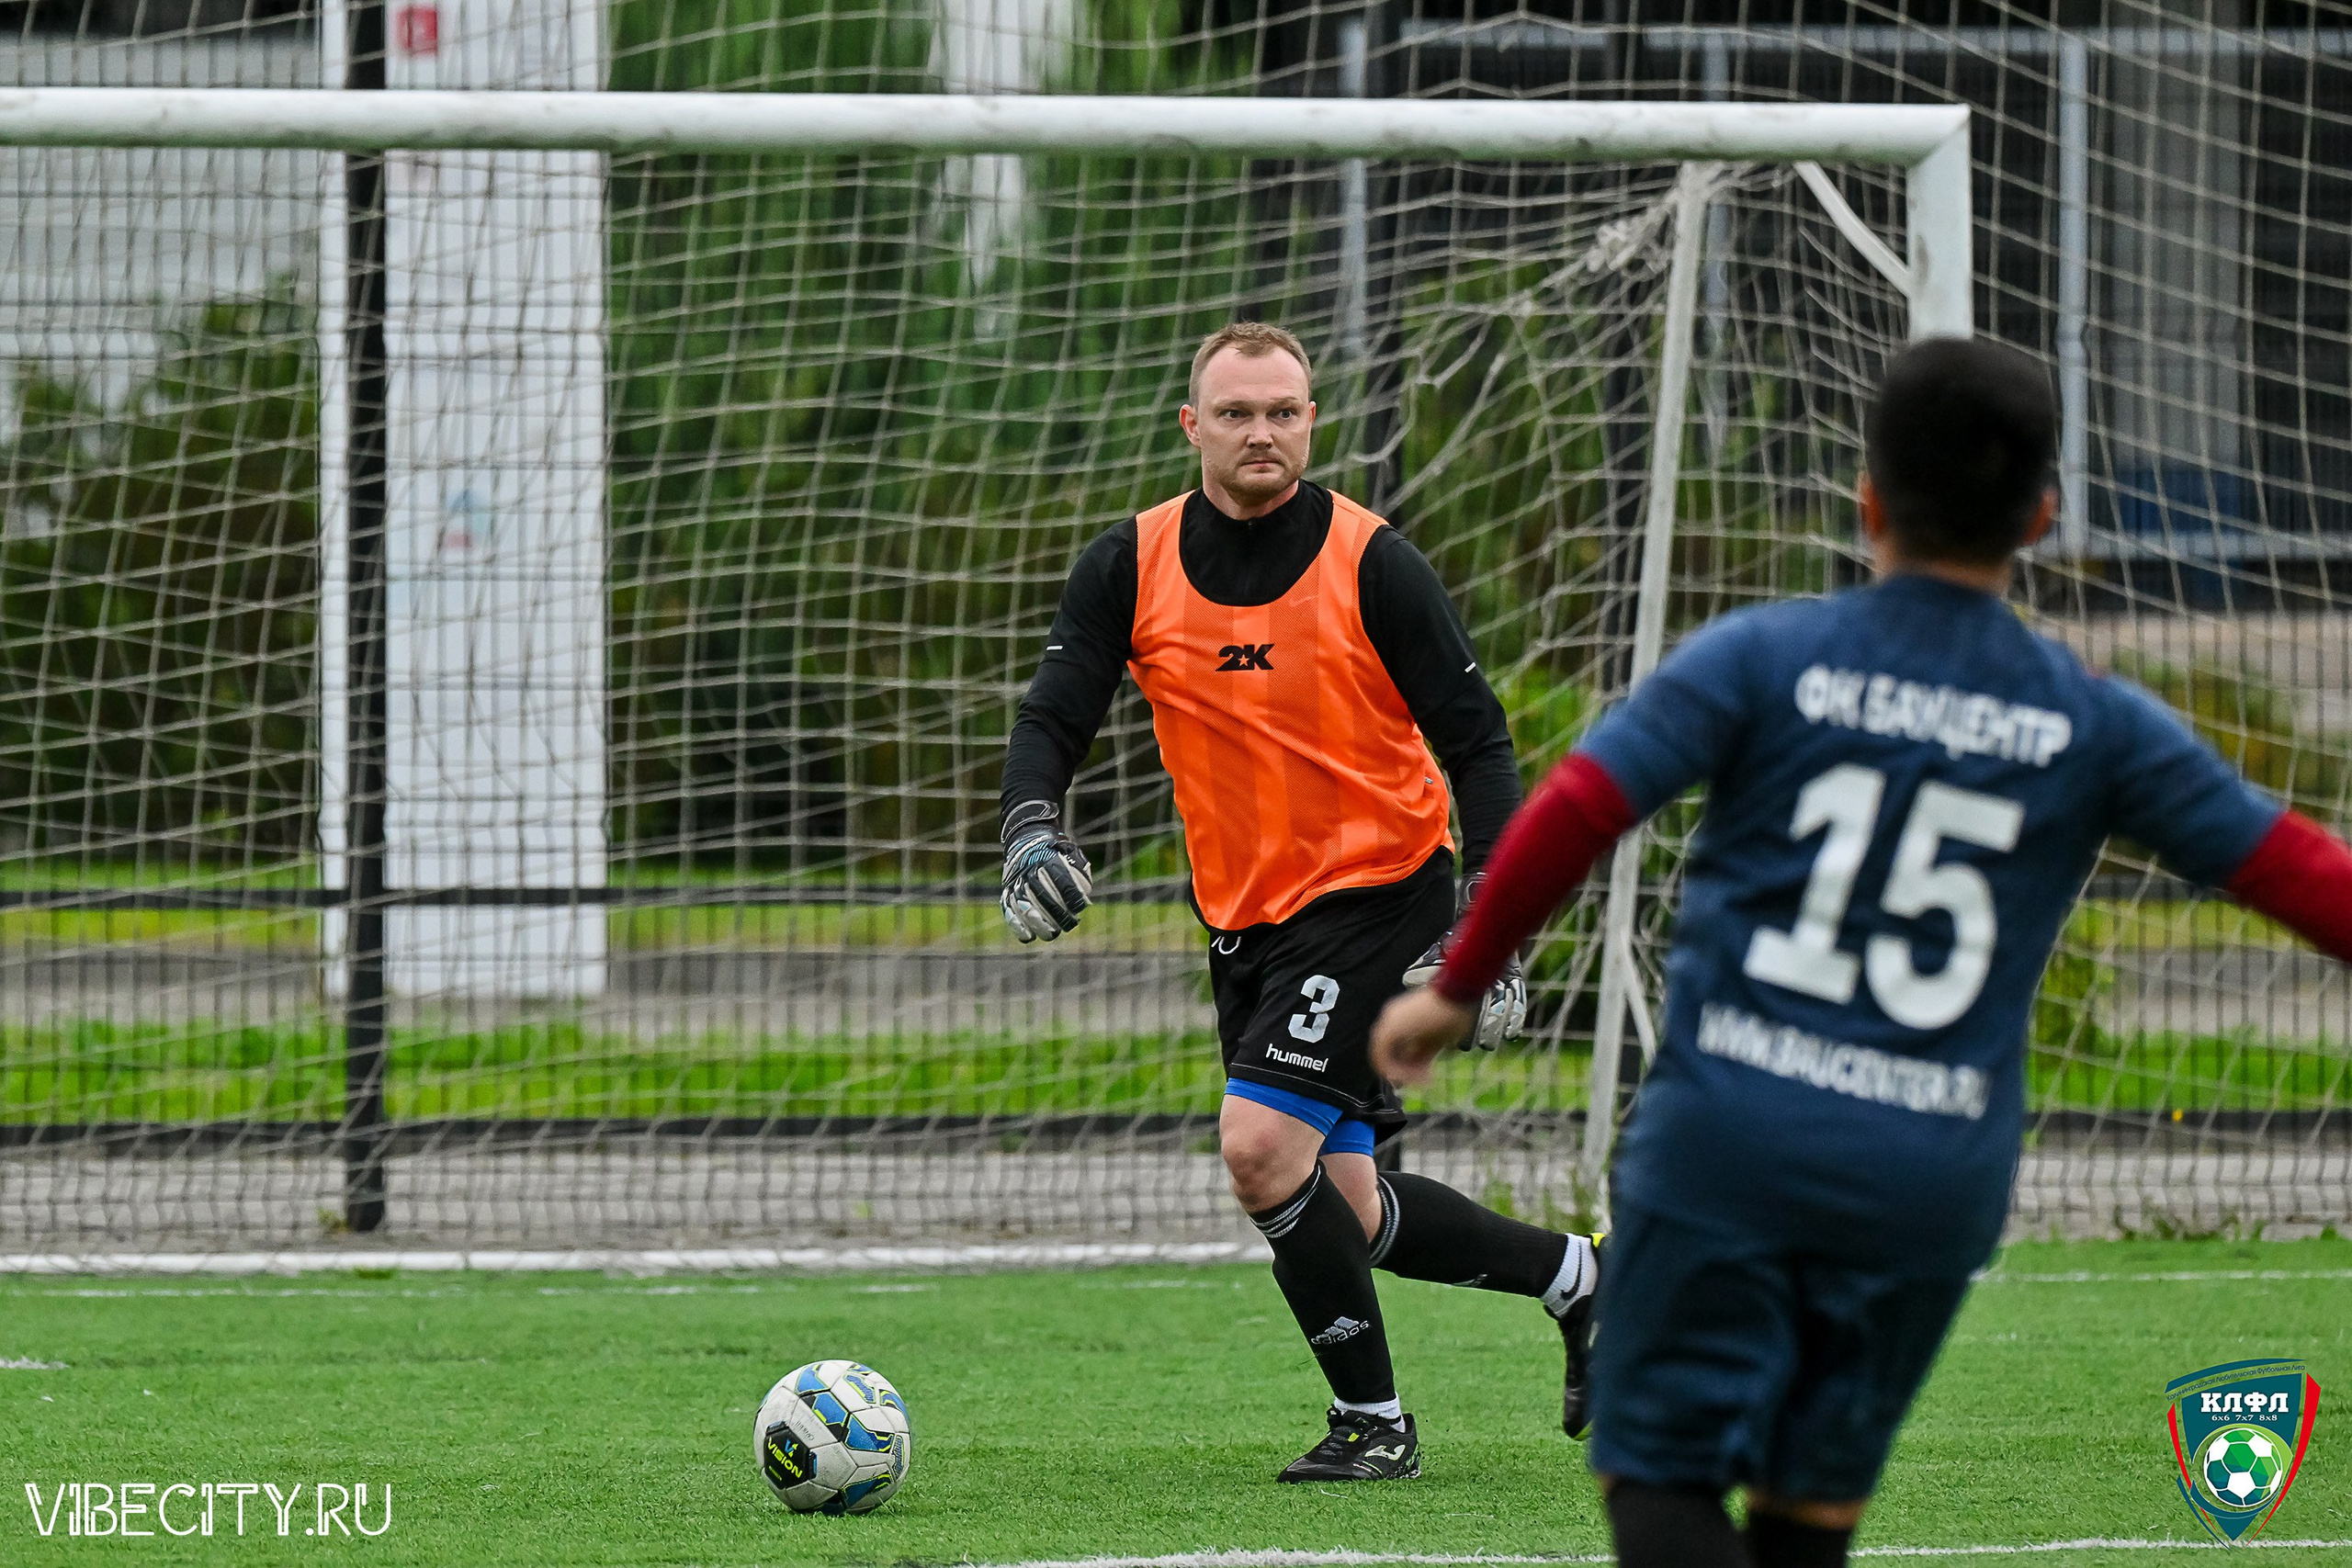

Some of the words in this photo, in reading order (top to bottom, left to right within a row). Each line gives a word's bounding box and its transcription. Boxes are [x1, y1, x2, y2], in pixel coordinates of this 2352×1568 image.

[1216, 644, 1274, 671] 2K
[1743, 761, 2025, 1030] 15
[1287, 975, 1340, 1043] 3
[1265, 1043, 1329, 1073] hummel
[1310, 1320, 1370, 1345] adidas
[766, 1436, 803, 1479] VISION
